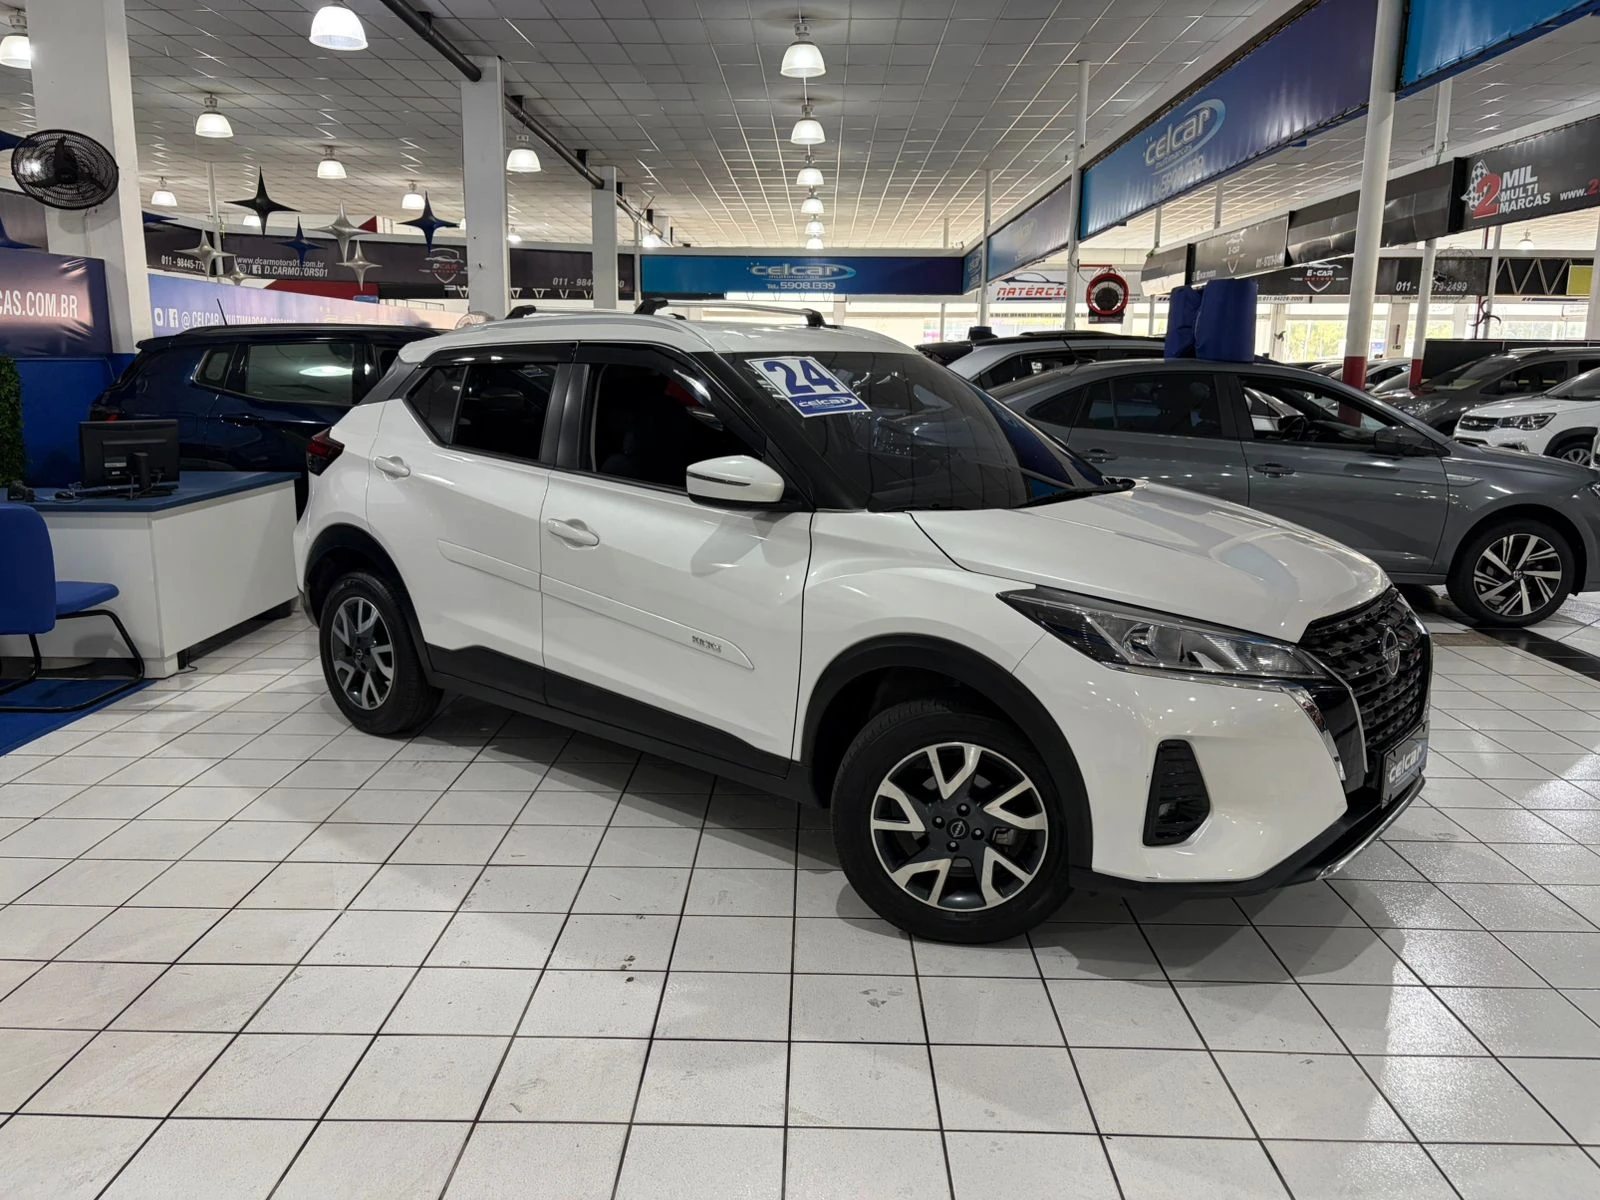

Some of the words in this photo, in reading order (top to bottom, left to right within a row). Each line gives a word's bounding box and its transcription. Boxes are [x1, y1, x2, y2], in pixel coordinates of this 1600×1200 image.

[1145, 108, 1210, 166] celcar
[1473, 174, 1501, 219] 2
[1501, 165, 1538, 190] MIL
[1500, 183, 1539, 203] MULTI
[1500, 192, 1551, 214] MARCAS
[161, 255, 172, 265] 011
[750, 264, 839, 276] celcar
[553, 277, 568, 286] 011
[1396, 281, 1411, 292] 011
[763, 360, 840, 395] 24
[799, 399, 849, 407] celcar
[1389, 744, 1422, 783] celcar
